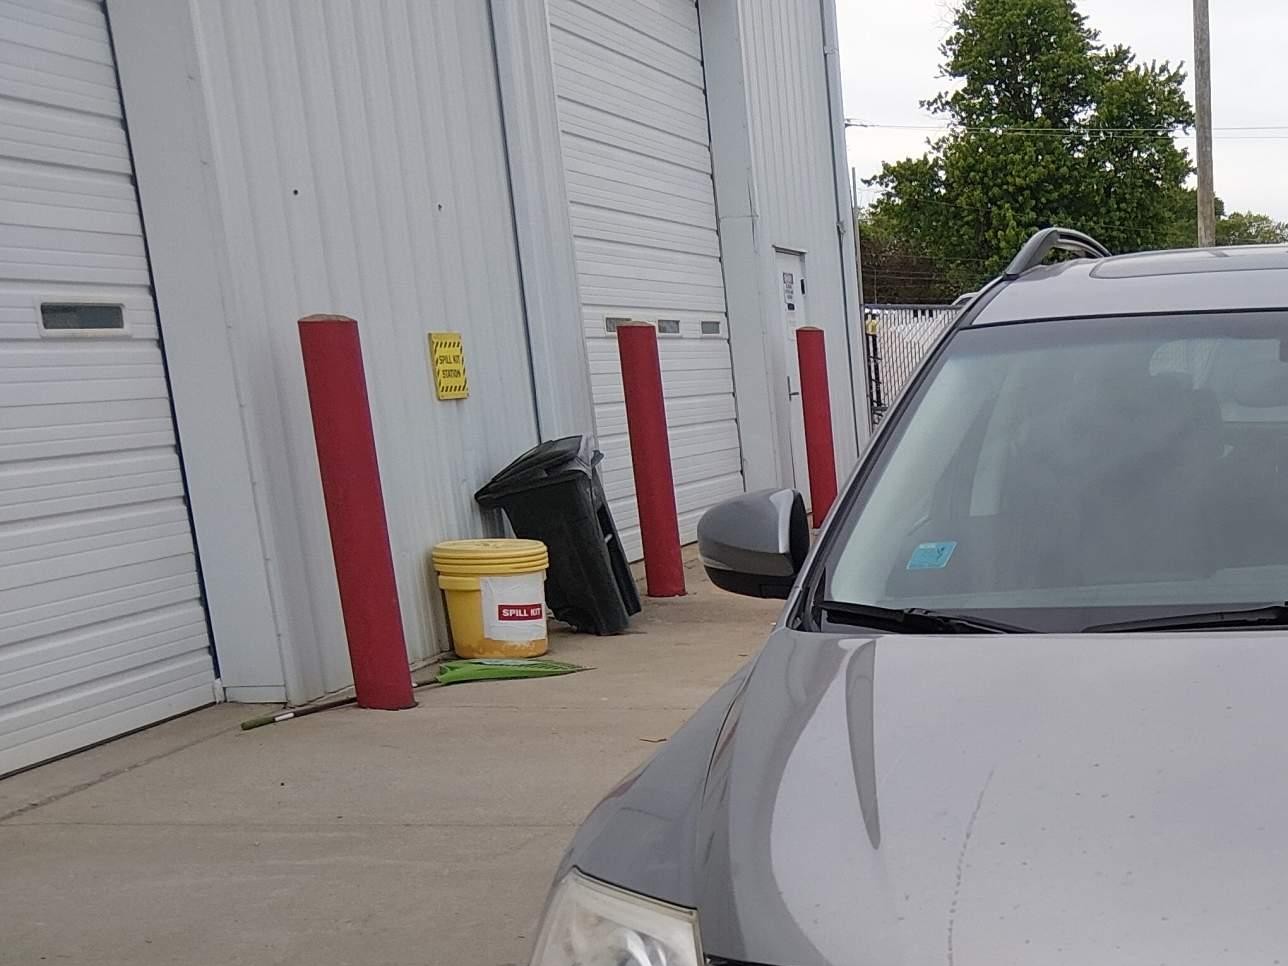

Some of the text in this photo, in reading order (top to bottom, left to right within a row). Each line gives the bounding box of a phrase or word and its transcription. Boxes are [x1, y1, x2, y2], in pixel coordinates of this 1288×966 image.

[439, 354, 461, 364] SPILL KIT
[442, 369, 461, 378] STATION
[502, 607, 542, 617] SPILL KIT
